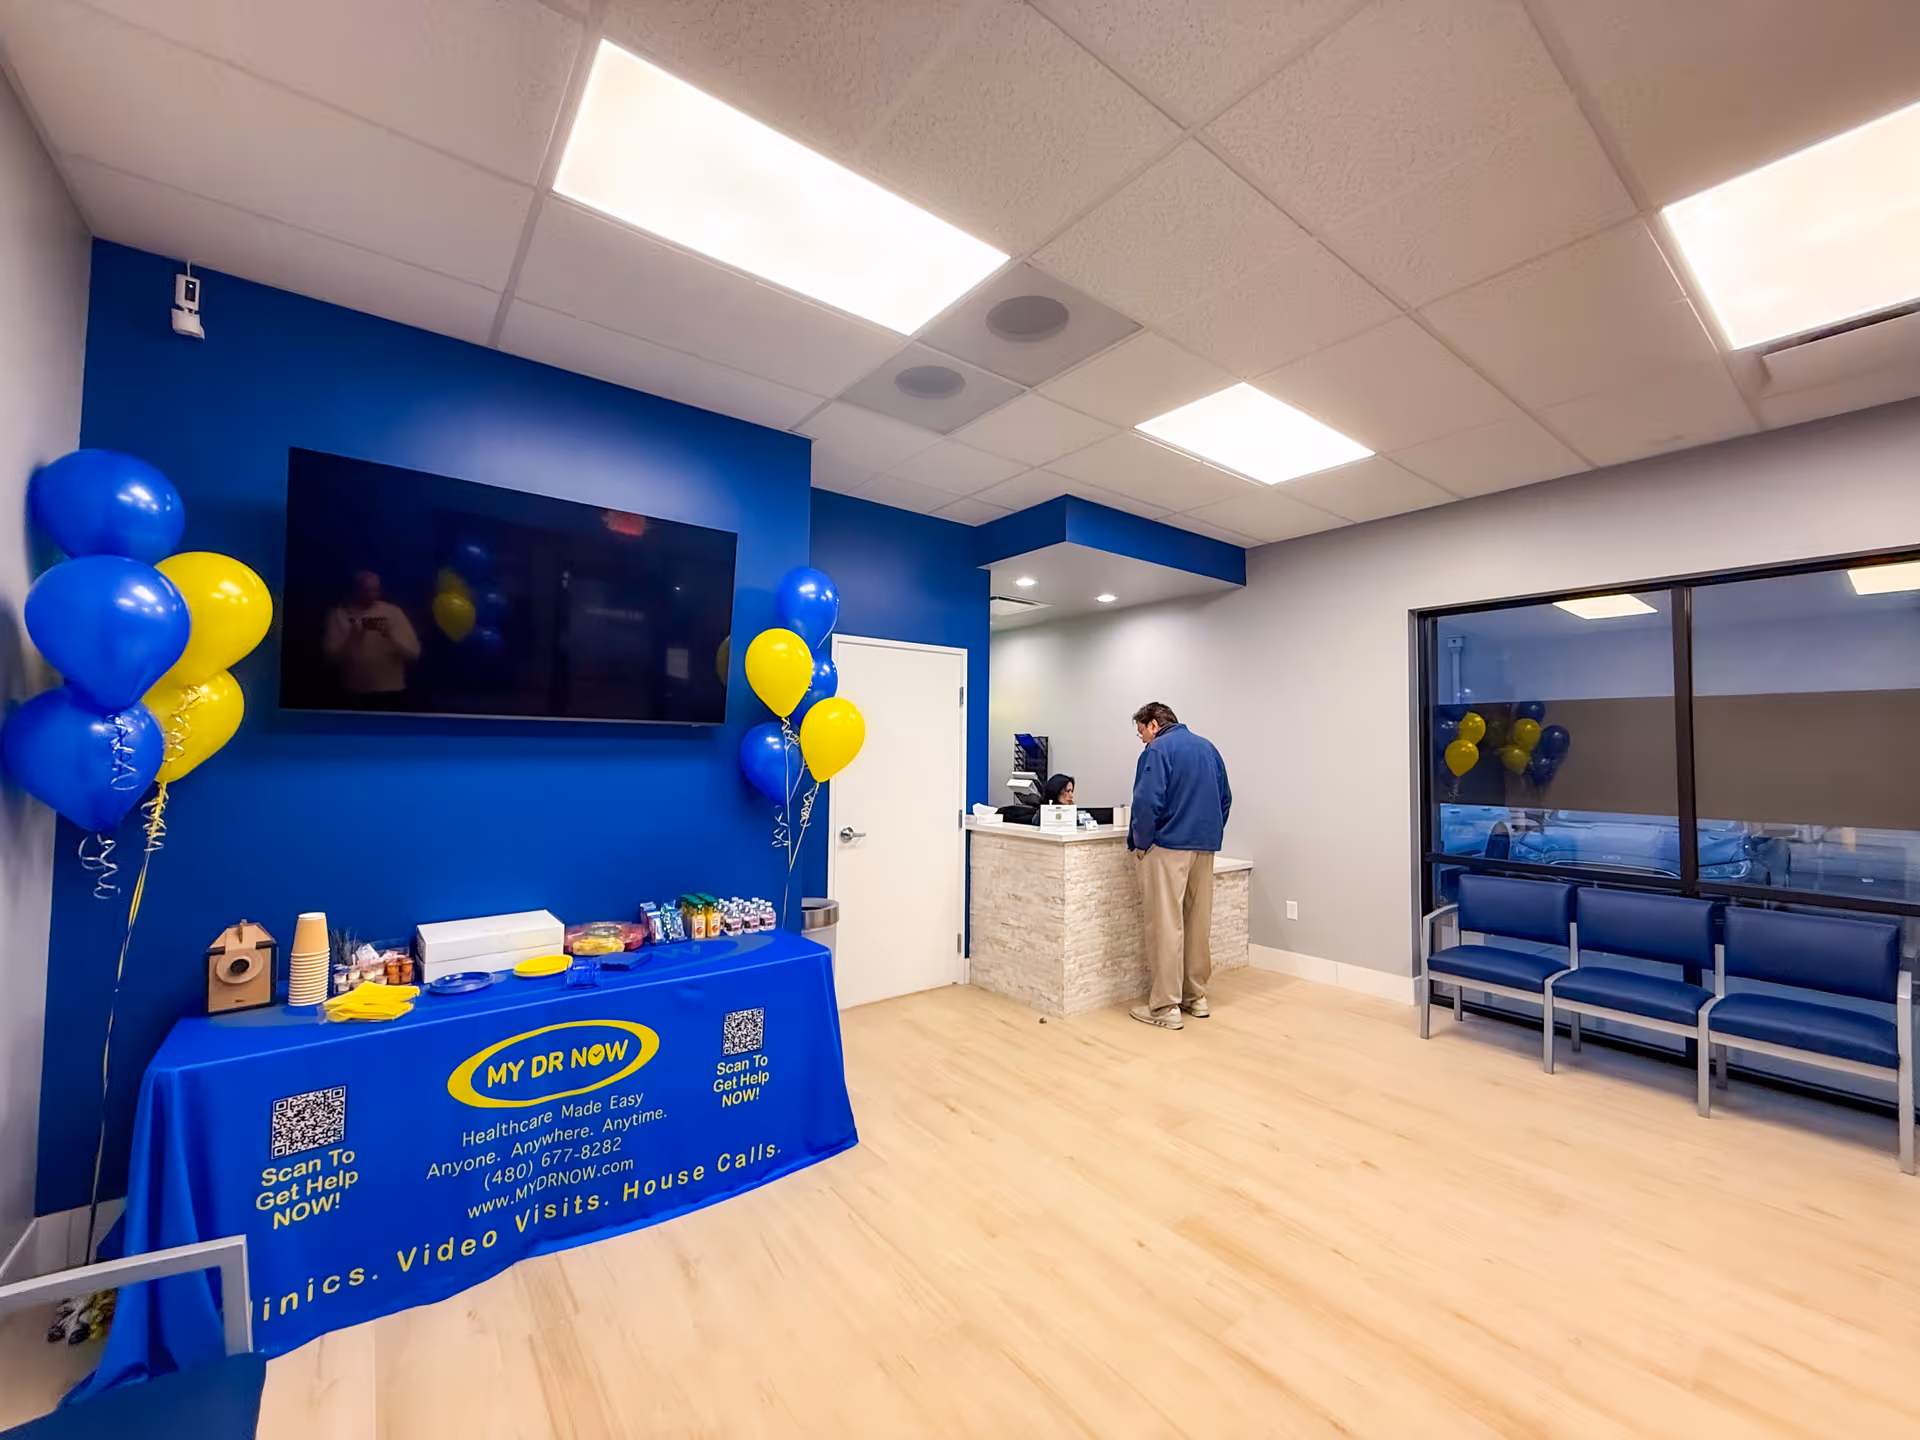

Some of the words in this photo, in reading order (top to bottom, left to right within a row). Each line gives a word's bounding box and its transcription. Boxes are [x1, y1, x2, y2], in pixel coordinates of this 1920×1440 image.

[487, 1059, 524, 1088] MY
[531, 1051, 564, 1079] DR
[571, 1039, 629, 1070] NOW
[713, 1076, 737, 1093] Get
[740, 1070, 769, 1087] Help
[716, 1060, 749, 1076] Scan
[752, 1054, 768, 1067] To
[462, 1111, 553, 1147] Healthcare
[561, 1100, 602, 1119] Made
[609, 1093, 644, 1111] Easy
[722, 1087, 759, 1108] NOW!
[426, 1152, 501, 1180] Anyone.
[511, 1126, 594, 1158] Anywhere.
[602, 1108, 668, 1134] Anytime.
[484, 1160, 533, 1192] (480)
[541, 1137, 622, 1168] 677-8282
[255, 1183, 300, 1211] Get
[306, 1169, 358, 1196] Help
[261, 1159, 321, 1187] Scan
[328, 1148, 355, 1167] To
[467, 1158, 634, 1219] www.MYDRNOW.com
[273, 1192, 340, 1230] NOW!
[397, 1230, 498, 1272] Video
[514, 1194, 609, 1233] Visits.
[623, 1165, 705, 1202] House
[717, 1143, 782, 1173] Calls.
